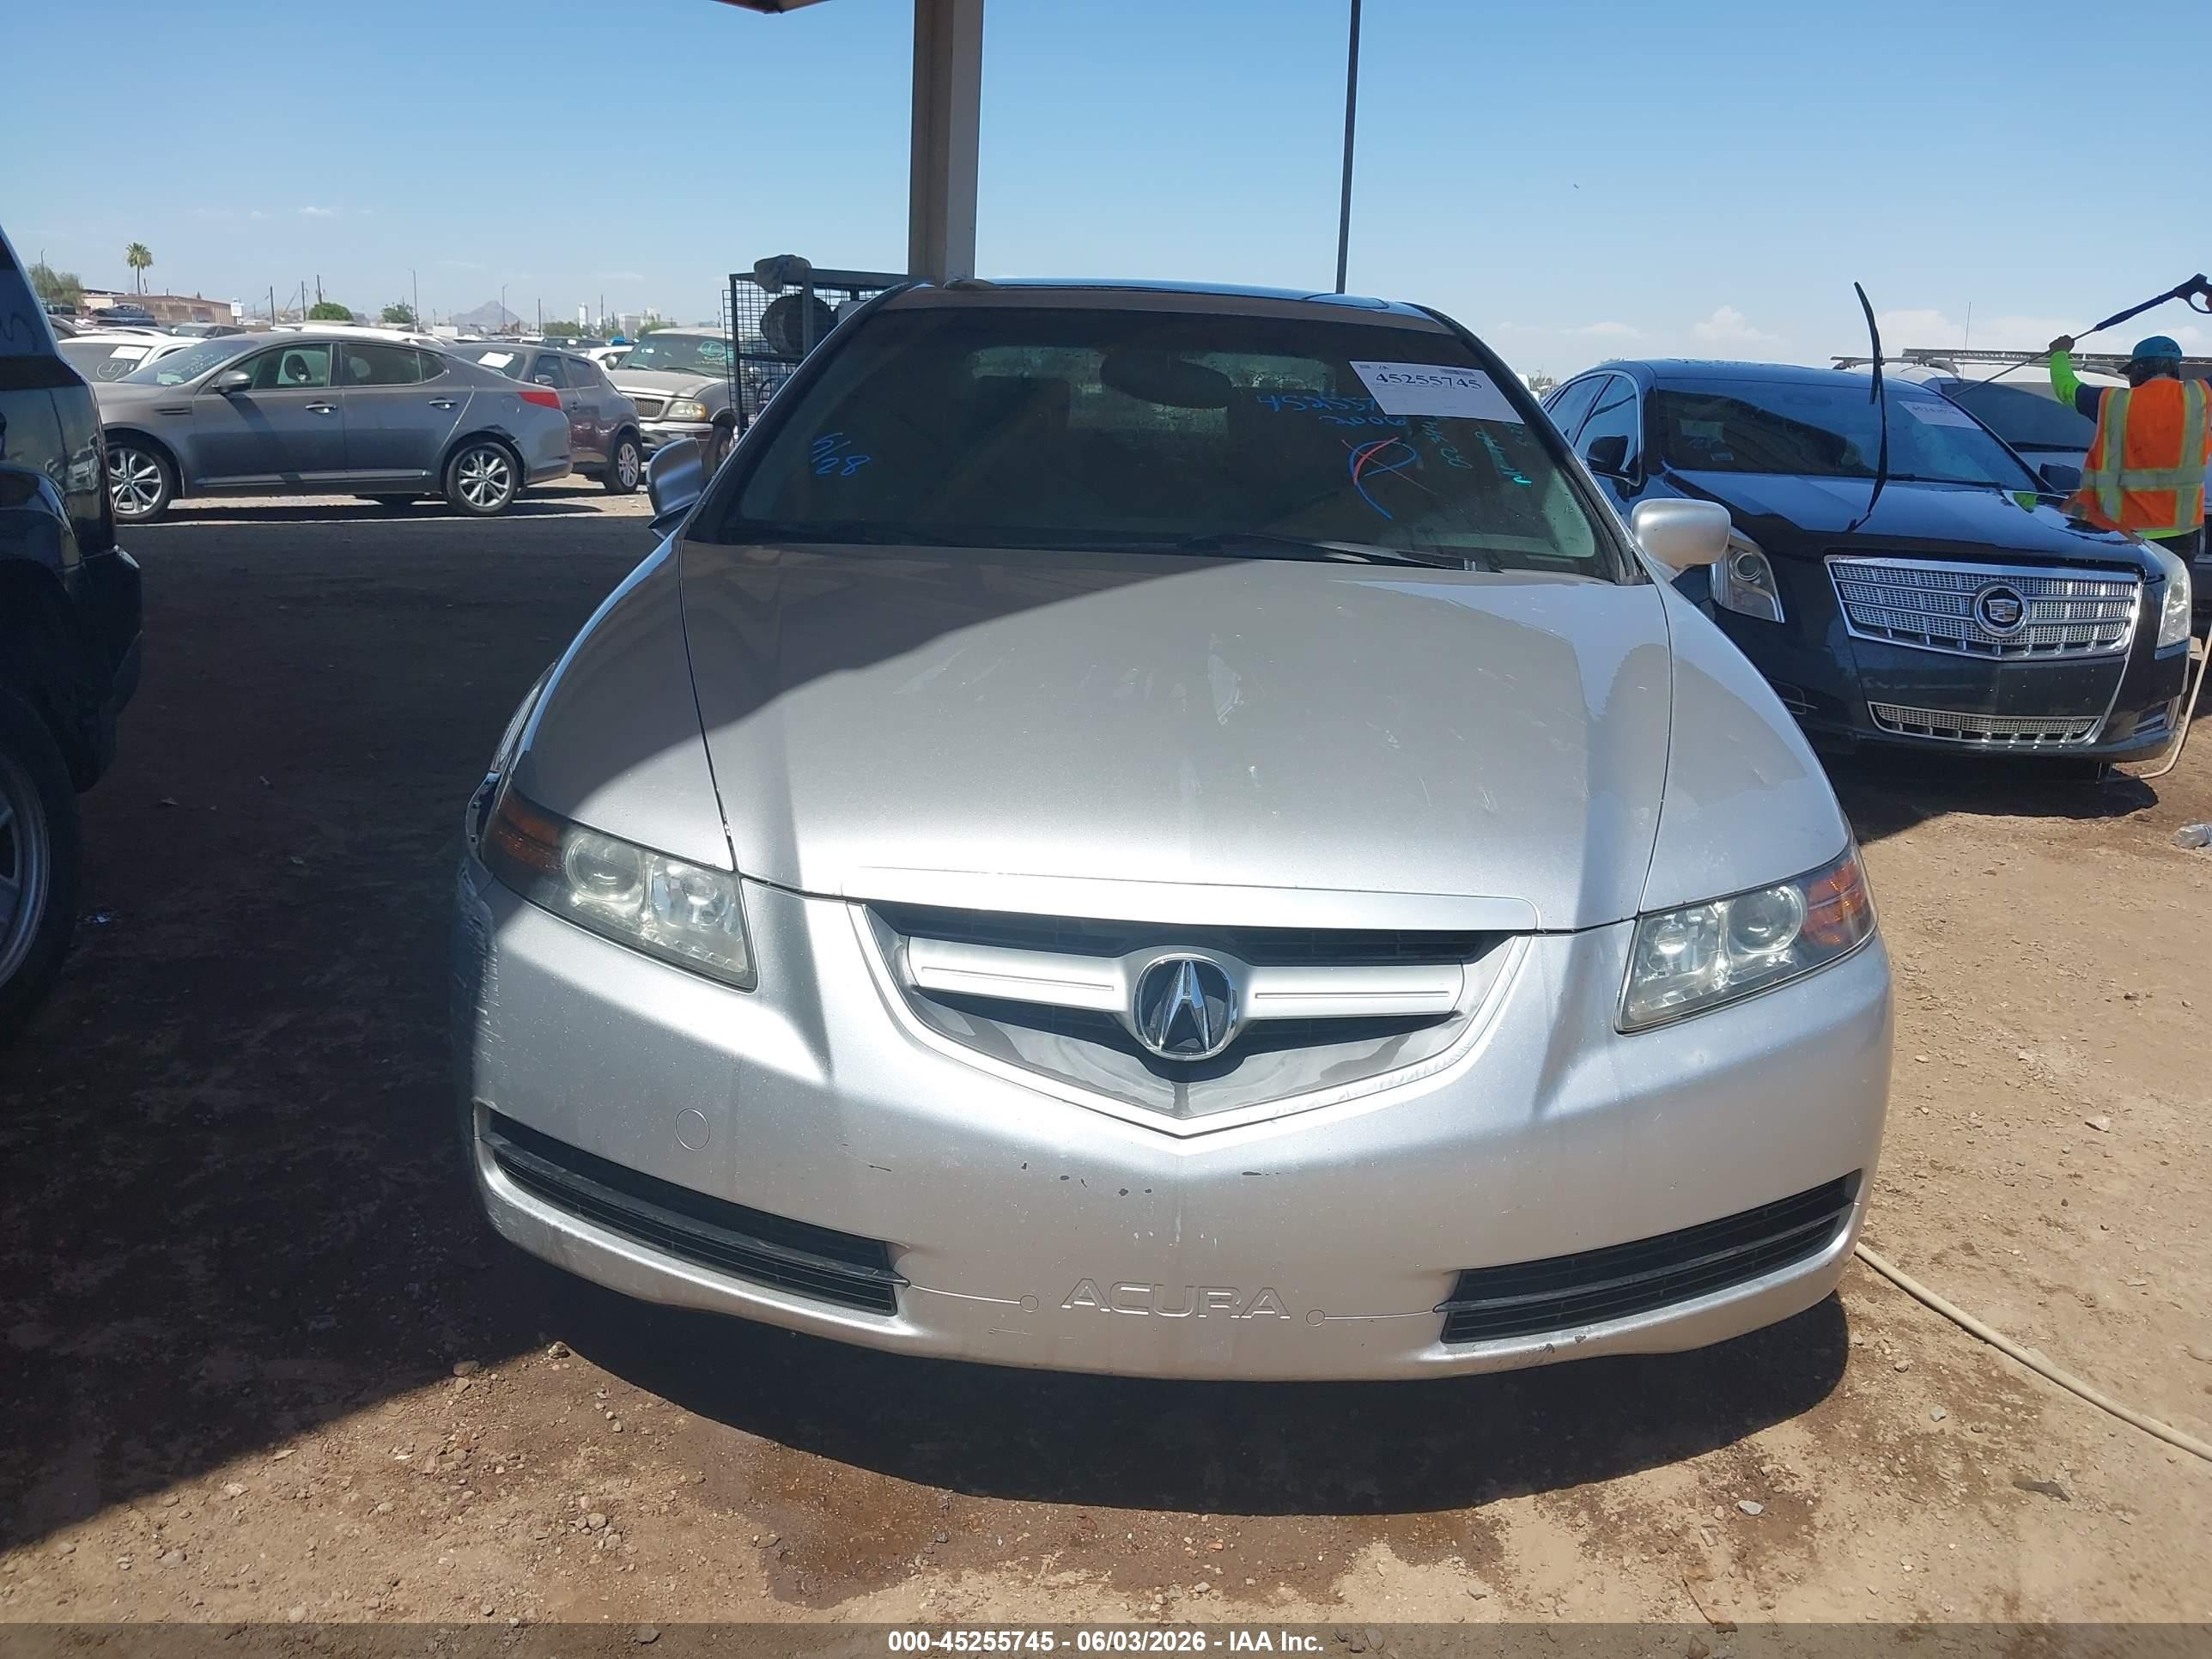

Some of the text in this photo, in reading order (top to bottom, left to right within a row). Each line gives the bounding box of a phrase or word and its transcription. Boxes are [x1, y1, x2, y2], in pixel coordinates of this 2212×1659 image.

[1376, 373, 1483, 391] 45255745
[1319, 416, 1407, 426] 2006
[1060, 1278, 1291, 1320] ACURA
